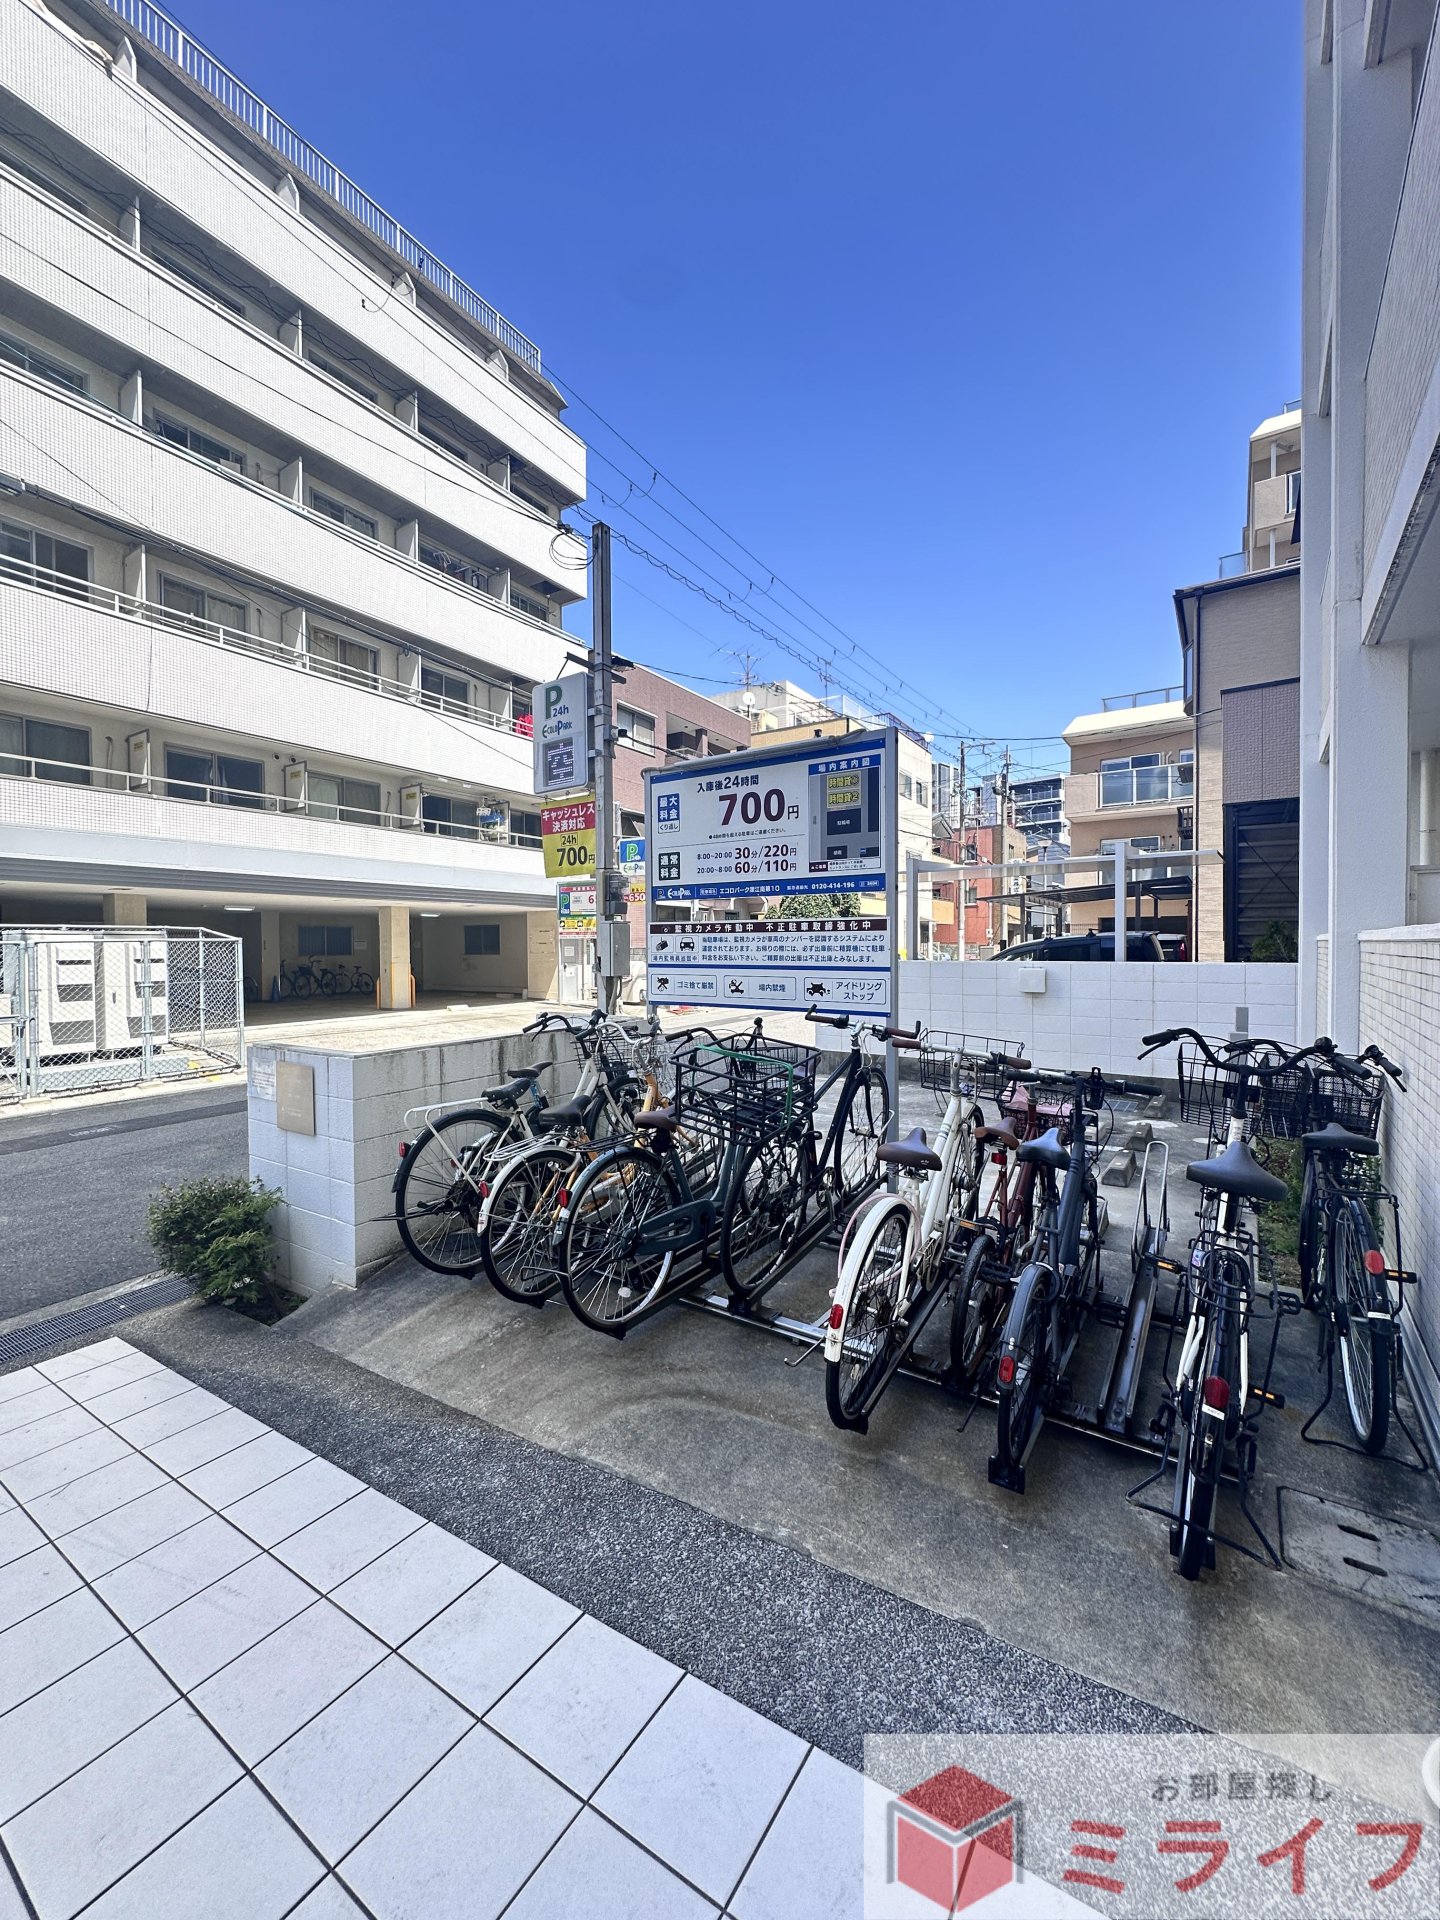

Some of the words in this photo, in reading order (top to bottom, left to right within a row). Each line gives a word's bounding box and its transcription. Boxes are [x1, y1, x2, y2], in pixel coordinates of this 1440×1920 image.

[545, 685, 562, 719] P
[553, 704, 569, 718] 24h
[697, 775, 759, 793] 入庫後24時間
[659, 796, 678, 807] 最大
[719, 788, 799, 826] 700円
[542, 803, 595, 821] キャッシュレス
[659, 809, 678, 820] 料金
[552, 817, 585, 833] 決済対応
[561, 834, 577, 846] 24h
[557, 846, 595, 866] 700円
[627, 844, 639, 861] P
[660, 854, 678, 865] 通常
[660, 867, 679, 878] 料金
[811, 882, 855, 890] 0120-414-196
[674, 923, 754, 933] 監視カメラ作動中
[765, 920, 871, 932] 不正駐車取締強化中
[836, 981, 882, 991] アイドリング
[843, 992, 875, 1001] ストップ
